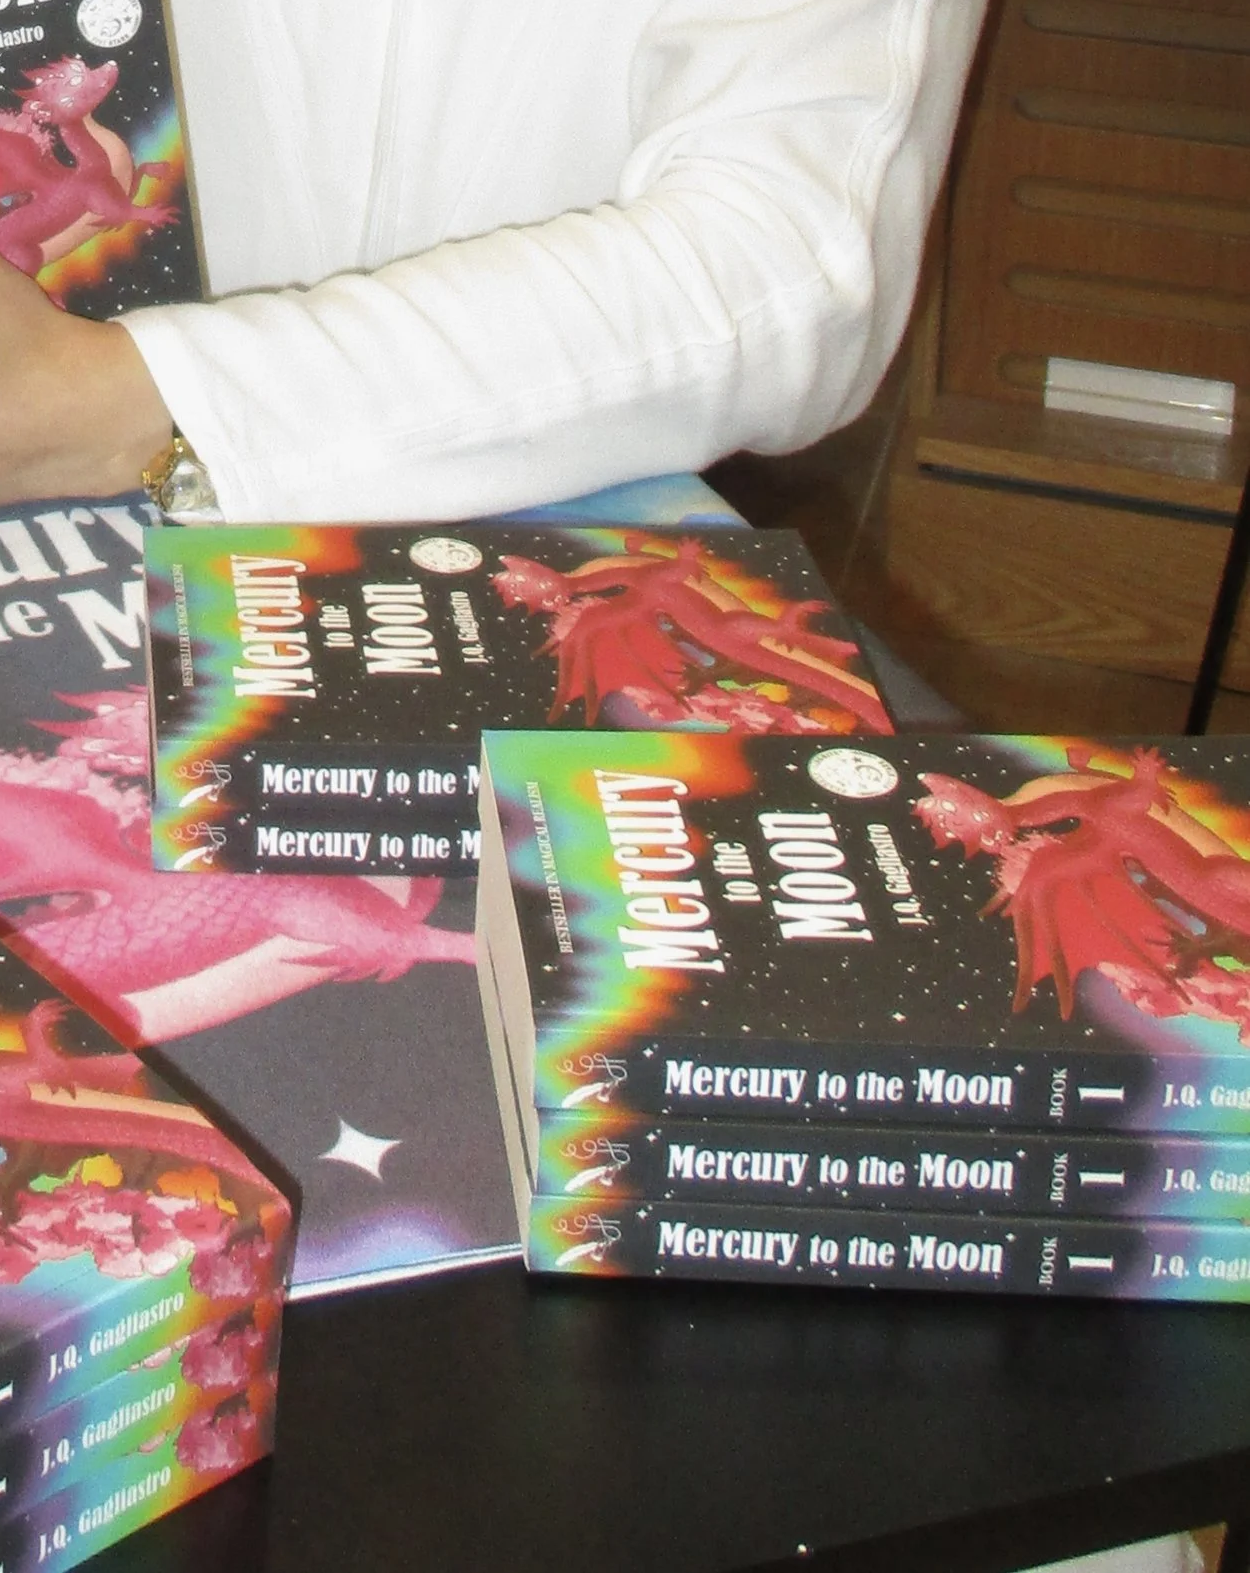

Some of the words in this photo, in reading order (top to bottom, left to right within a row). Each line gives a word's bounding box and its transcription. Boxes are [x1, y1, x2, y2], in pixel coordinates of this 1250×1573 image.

[230, 554, 317, 698] Mercury
[319, 604, 352, 629] the
[362, 584, 442, 675] Moon
[262, 763, 377, 797] Mercury
[387, 771, 410, 794] to
[418, 768, 456, 795] the
[256, 826, 371, 859] Mercury
[381, 834, 403, 858] to
[412, 831, 450, 858] the
[593, 769, 726, 973] Mercury
[713, 841, 754, 876] the
[867, 823, 913, 894] Gagliastro
[723, 879, 761, 903] to
[758, 812, 873, 942] Moon
[665, 1060, 807, 1102] Mercury
[817, 1070, 846, 1100] to
[856, 1071, 903, 1102] the
[916, 1068, 1013, 1107] Moon
[667, 1144, 808, 1186] Mercury
[819, 1154, 848, 1184] to
[858, 1155, 905, 1186] the
[918, 1153, 1014, 1190] Moon
[657, 1221, 798, 1266] Mercury
[809, 1233, 838, 1264] to
[848, 1234, 895, 1267] the
[908, 1232, 1004, 1274] Moon
[49, 1343, 83, 1382] J.Q.
[89, 1290, 185, 1358] Gagliastro
[40, 1438, 75, 1476] J.Q.
[82, 1381, 176, 1449] Gagliastro
[38, 1524, 72, 1563] J.Q.
[78, 1465, 171, 1535] Gagliastro
